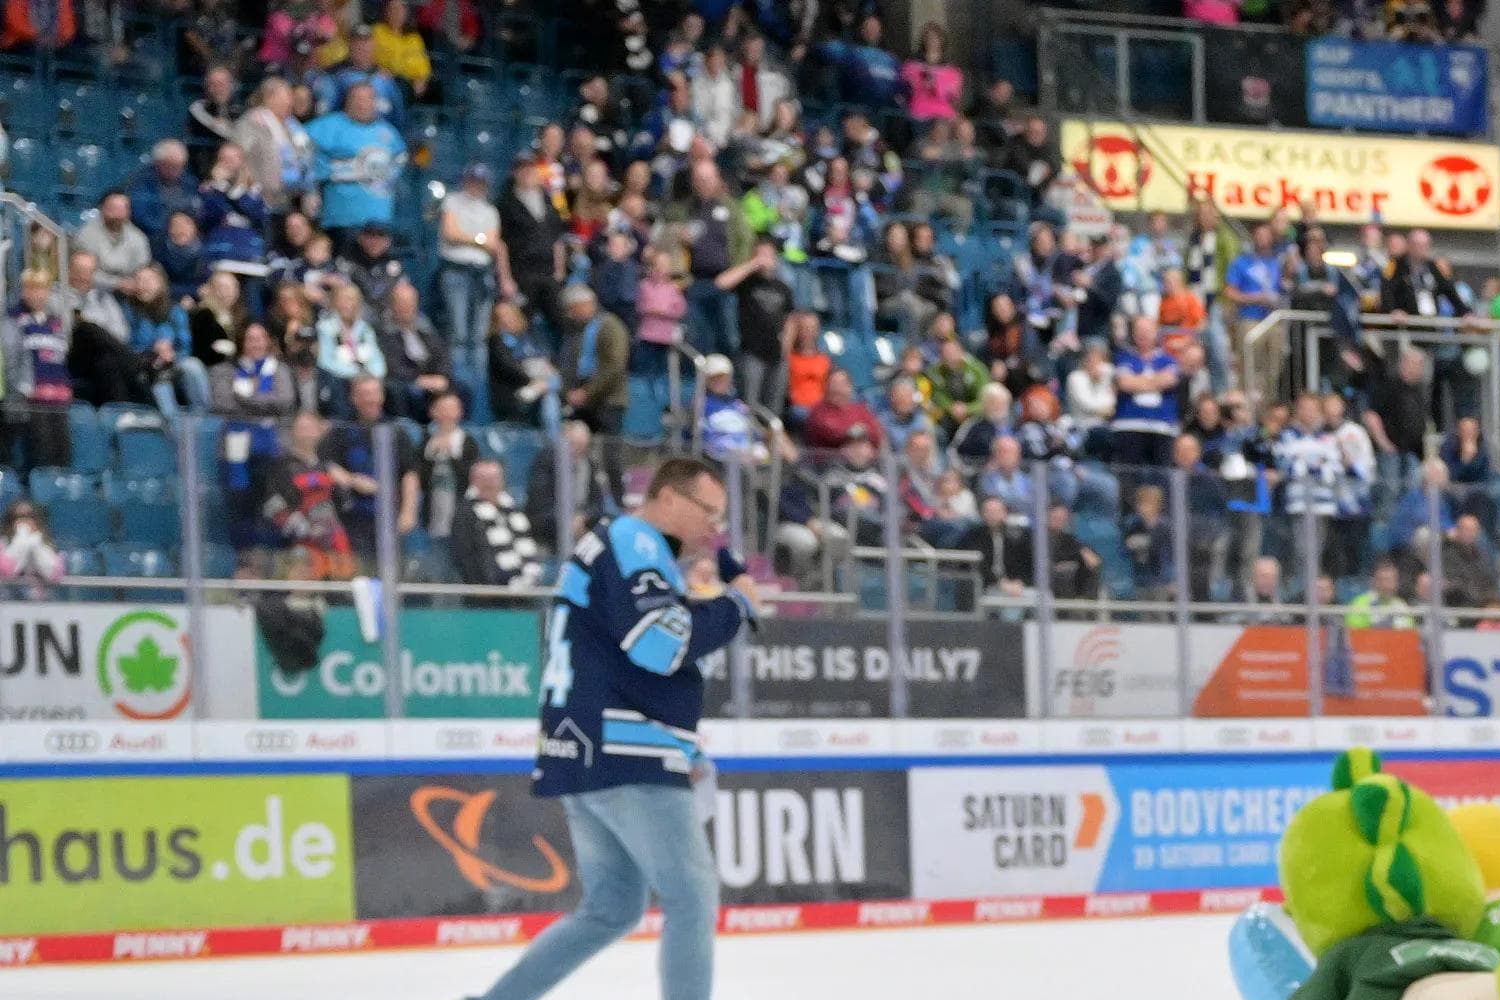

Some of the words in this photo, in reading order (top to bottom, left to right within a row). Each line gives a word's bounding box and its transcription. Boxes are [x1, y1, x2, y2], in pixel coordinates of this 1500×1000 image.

[1181, 137, 1391, 175] BACKHAUS
[1187, 171, 1389, 212] Hackner
[317, 650, 530, 696] Colomix
[822, 647, 856, 680] IS
[962, 794, 1067, 830] SATURN
[1131, 787, 1325, 837] BODYCHEC
[0, 795, 338, 884] haus.de
[993, 835, 1067, 868] CARD
